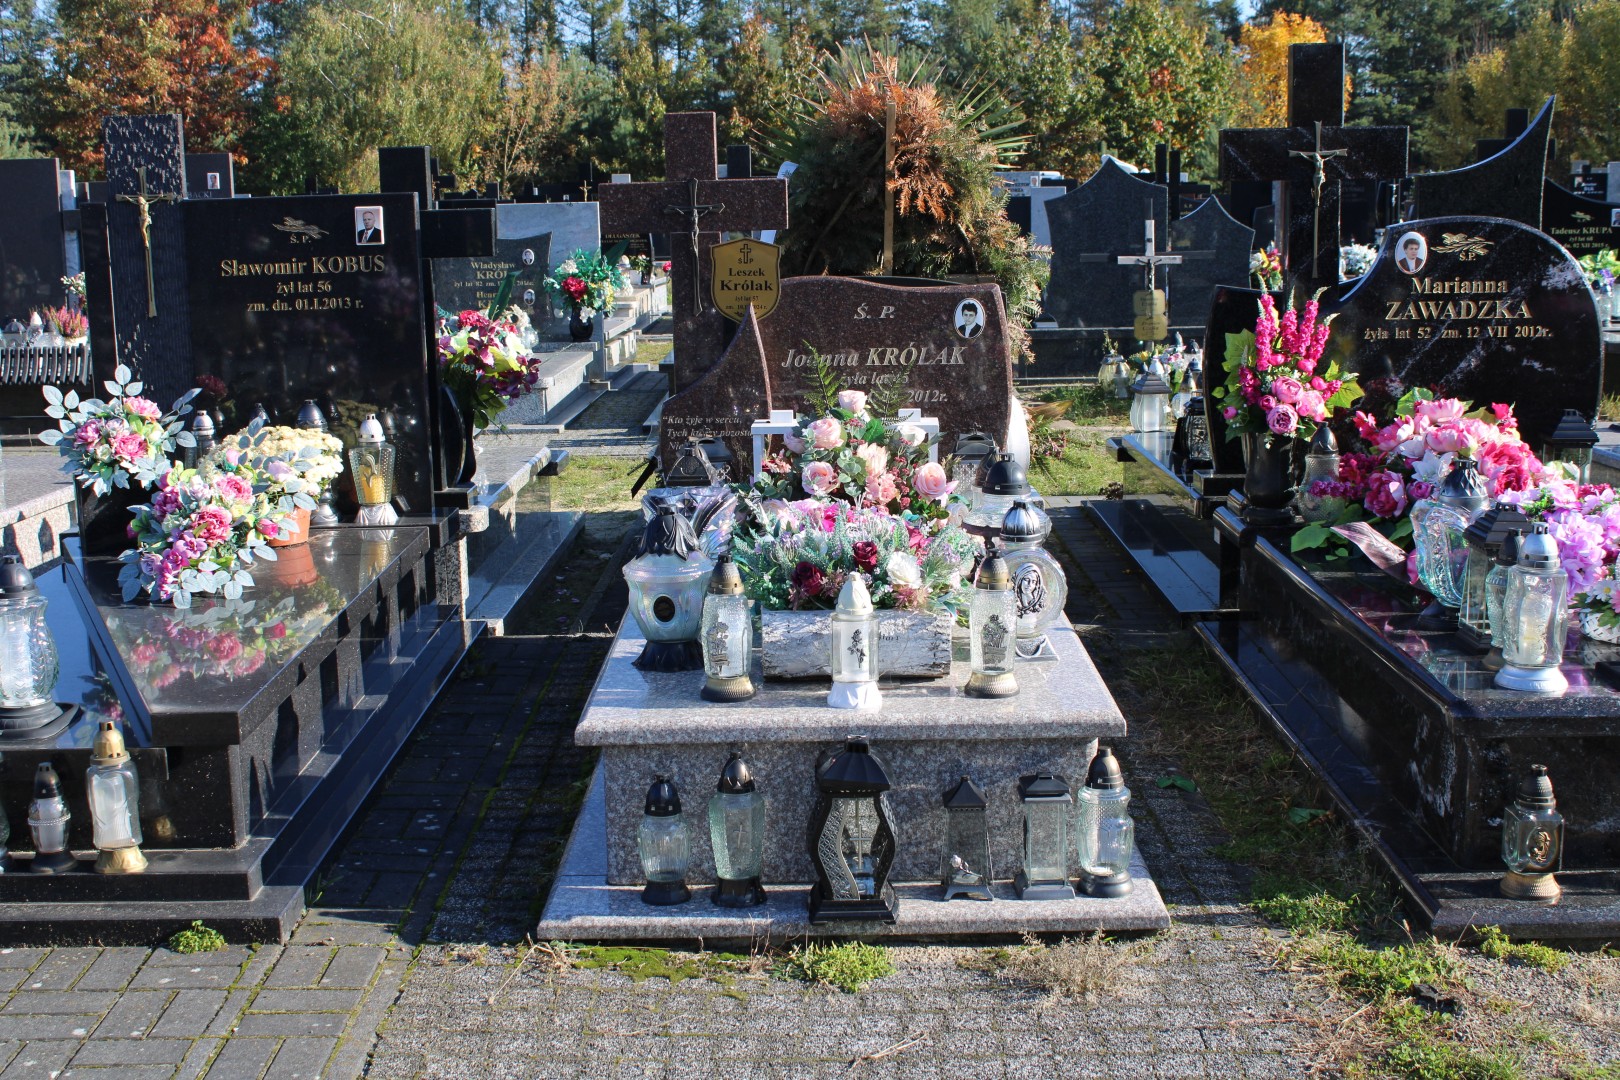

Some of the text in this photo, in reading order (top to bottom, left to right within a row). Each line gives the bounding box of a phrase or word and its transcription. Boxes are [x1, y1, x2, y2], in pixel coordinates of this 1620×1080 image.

[290, 233, 312, 244] Ś. P.
[1551, 227, 1580, 235] Tadeusz
[220, 254, 386, 278] Sławomir KOBUS
[471, 261, 516, 271] Władysław
[728, 267, 766, 277] Leszek
[276, 280, 332, 297] żył lat 56
[720, 279, 773, 291] Królak
[1411, 276, 1509, 295] Marianna
[247, 301, 271, 312] zm.
[272, 300, 292, 311] dn.
[355, 299, 365, 309] r.
[854, 303, 895, 320] Ś. P.
[1385, 299, 1533, 321] ZAWADZKA
[1364, 325, 1553, 340] żyła lat 52 zm. 12 VII 2012r.
[865, 342, 968, 366] KRÓLAK
[841, 372, 867, 387] yła
[906, 389, 948, 404] 2012r.
[686, 415, 702, 426] żyje
[667, 428, 688, 440] Tych
